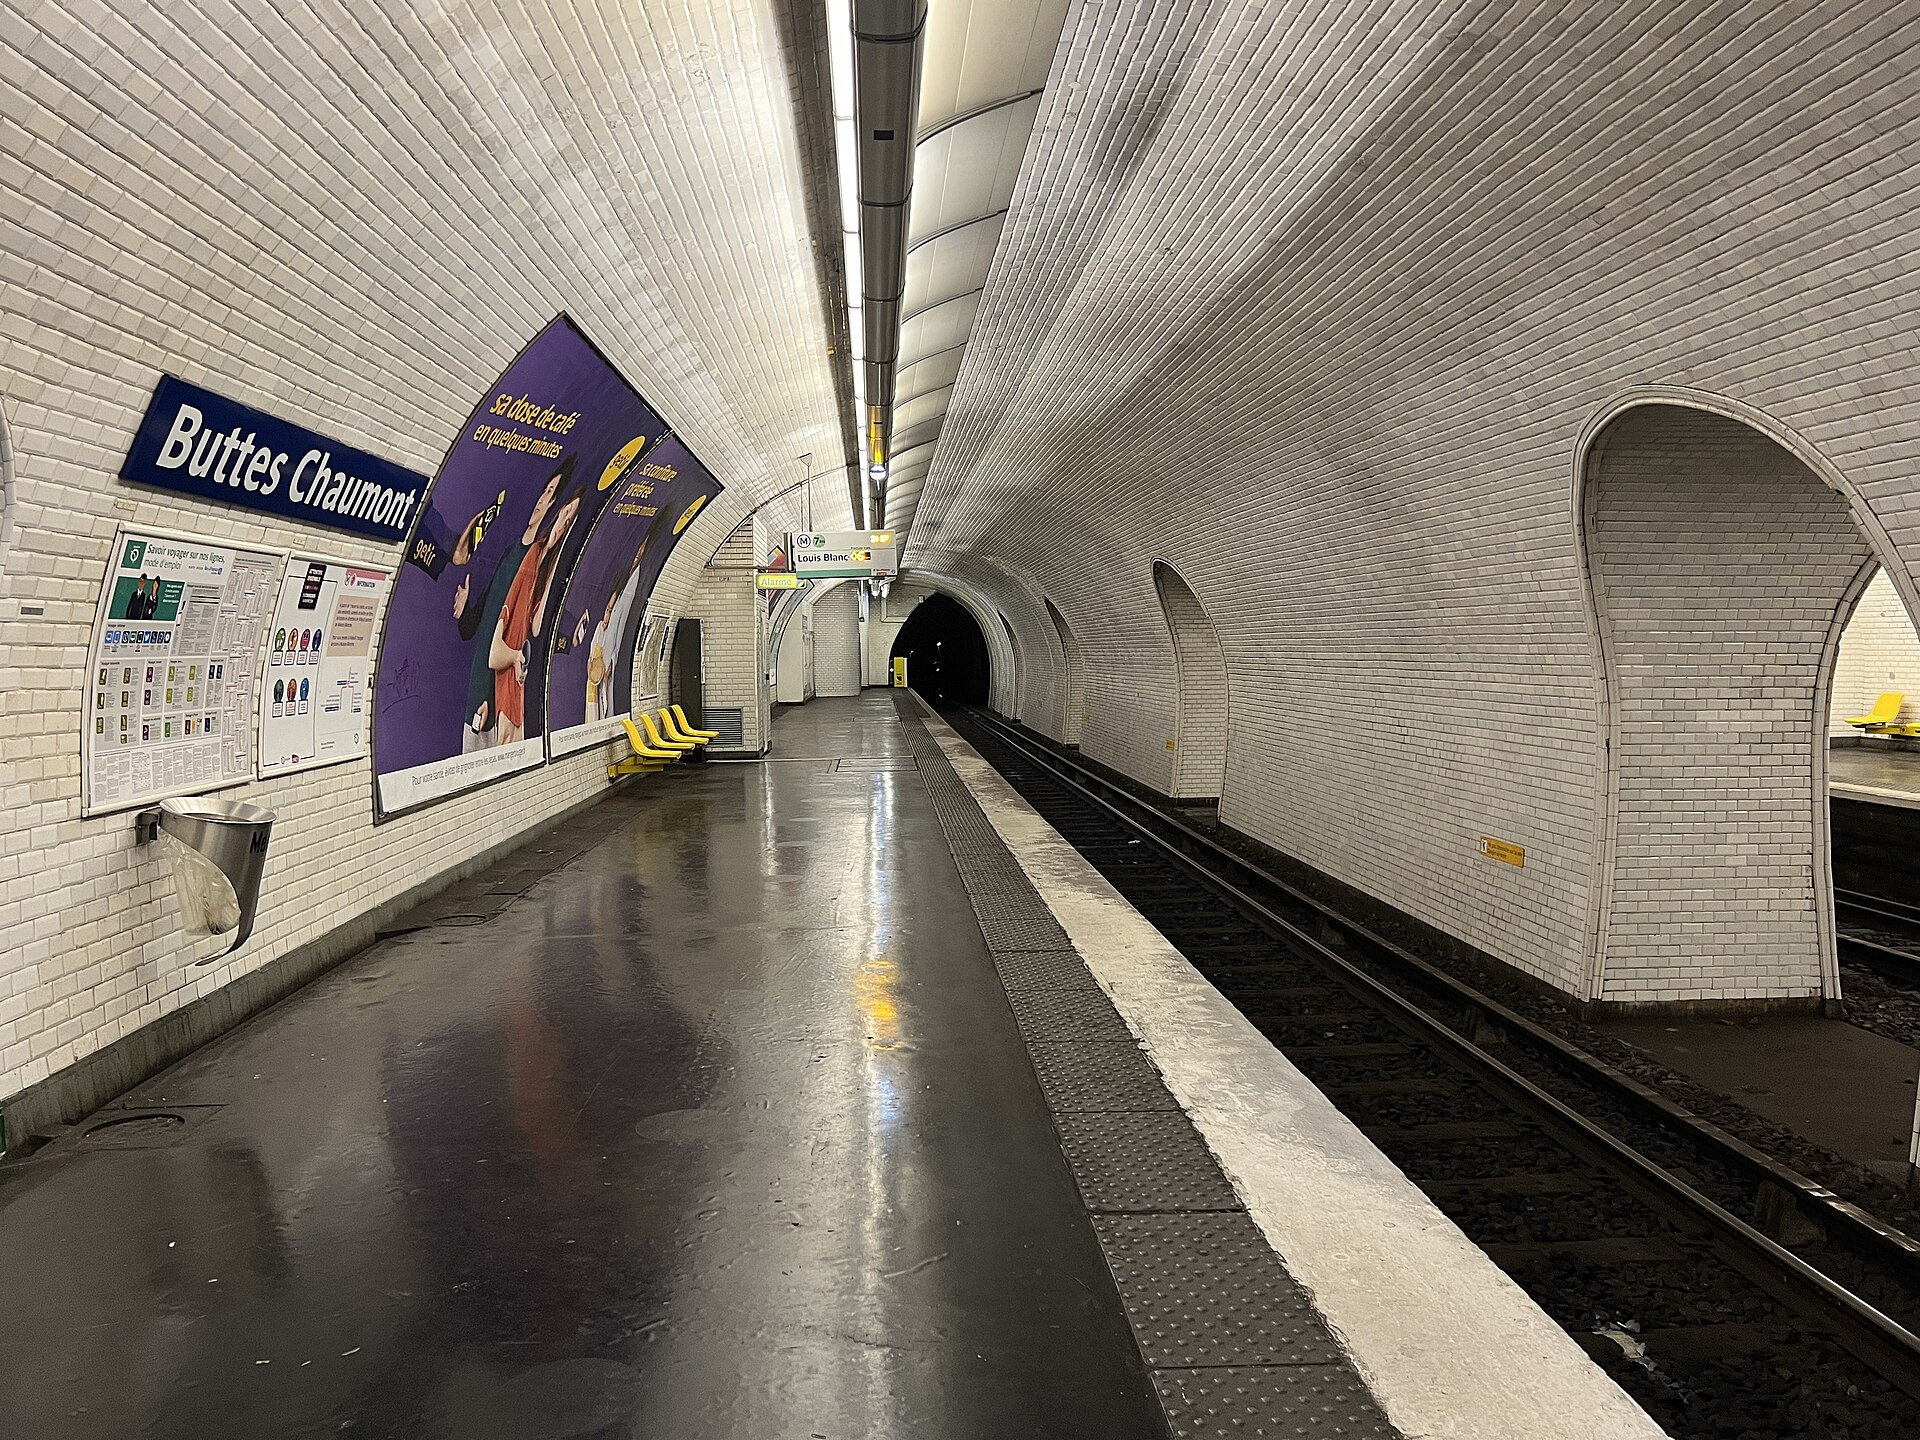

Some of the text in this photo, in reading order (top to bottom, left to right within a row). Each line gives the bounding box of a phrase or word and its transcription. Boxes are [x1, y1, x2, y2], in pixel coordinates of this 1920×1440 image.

[489, 393, 581, 435] sa dose de café
[473, 424, 563, 459] en quelques minutes
[156, 403, 417, 529] Buttes Chaumont
[147, 544, 167, 556] Savoir
[166, 547, 189, 560] voyager
[189, 551, 199, 559] sur
[199, 551, 209, 561] nos
[413, 539, 436, 567] getir
[798, 553, 849, 562] Louis Blanc
[144, 558, 160, 568] mode
[159, 560, 182, 571] d'emploi
[761, 578, 792, 586] Alarme
